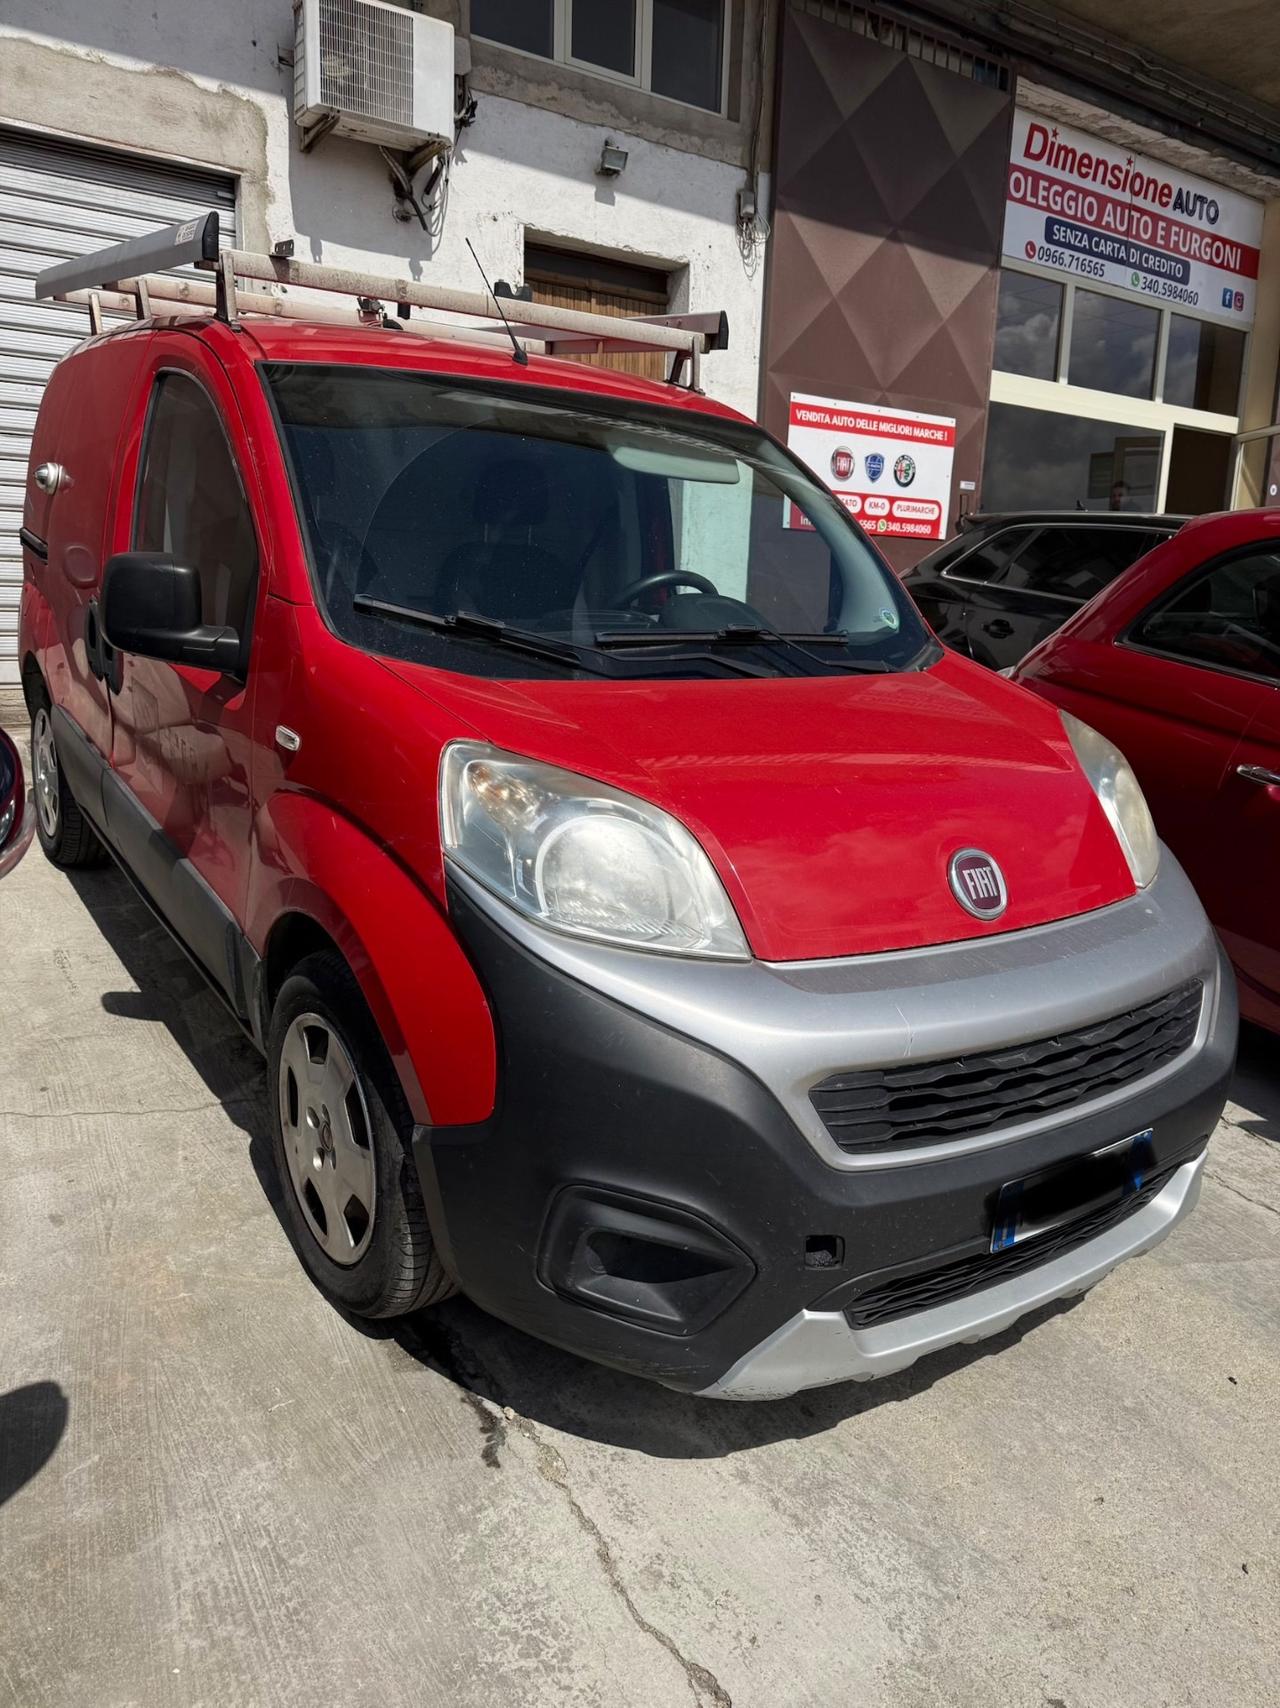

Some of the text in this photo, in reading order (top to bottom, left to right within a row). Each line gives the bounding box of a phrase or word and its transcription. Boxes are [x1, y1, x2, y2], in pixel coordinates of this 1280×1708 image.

[1023, 122, 1220, 225] Dimensione AUTO
[1009, 171, 1241, 271] OLEGGIO AUTO E FURGONI
[1037, 246, 1106, 278] 0966.716565
[1053, 225, 1183, 278] SENZA CARTA DI CREDITO
[1141, 276, 1199, 306] 340.5984060
[795, 408, 831, 425] VENDITA
[832, 414, 855, 428] AUTO
[856, 418, 878, 432] DELLE
[879, 421, 913, 436] MIGLIORI
[913, 427, 944, 440] MARCHE
[896, 503, 935, 515] PLURIMARCHE
[887, 521, 932, 534] 340.5984060
[962, 866, 998, 900] FIAT
